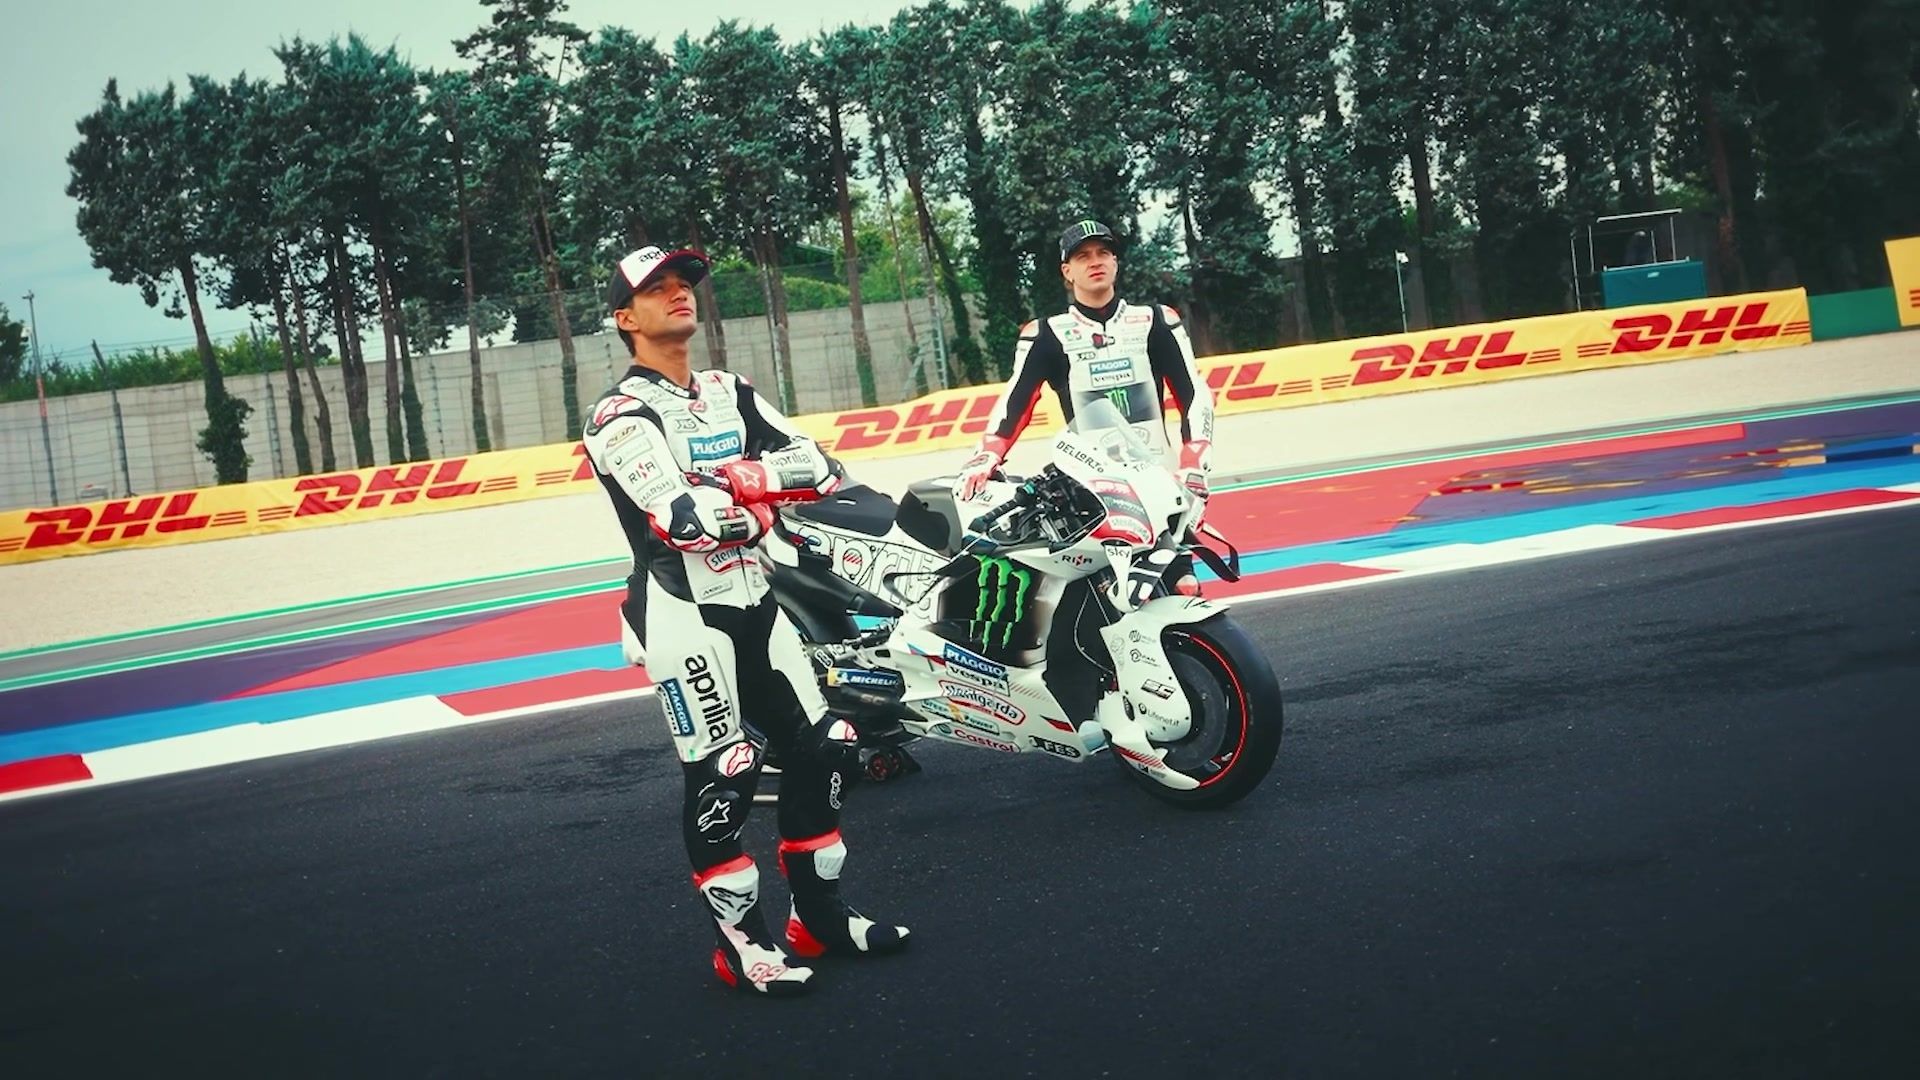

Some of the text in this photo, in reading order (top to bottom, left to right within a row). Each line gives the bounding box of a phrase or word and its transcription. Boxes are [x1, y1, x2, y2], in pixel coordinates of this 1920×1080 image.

[1609, 302, 1781, 355] DHL
[1351, 331, 1528, 386] DHL
[294, 458, 480, 518] DHL
[24, 492, 210, 550] DHL
[946, 649, 1004, 676] PIAGGIO
[949, 665, 1007, 690] vespa
[667, 681, 691, 734] PIAGGIO
[685, 654, 731, 743] aprilia
[955, 729, 1015, 752] Castrol
